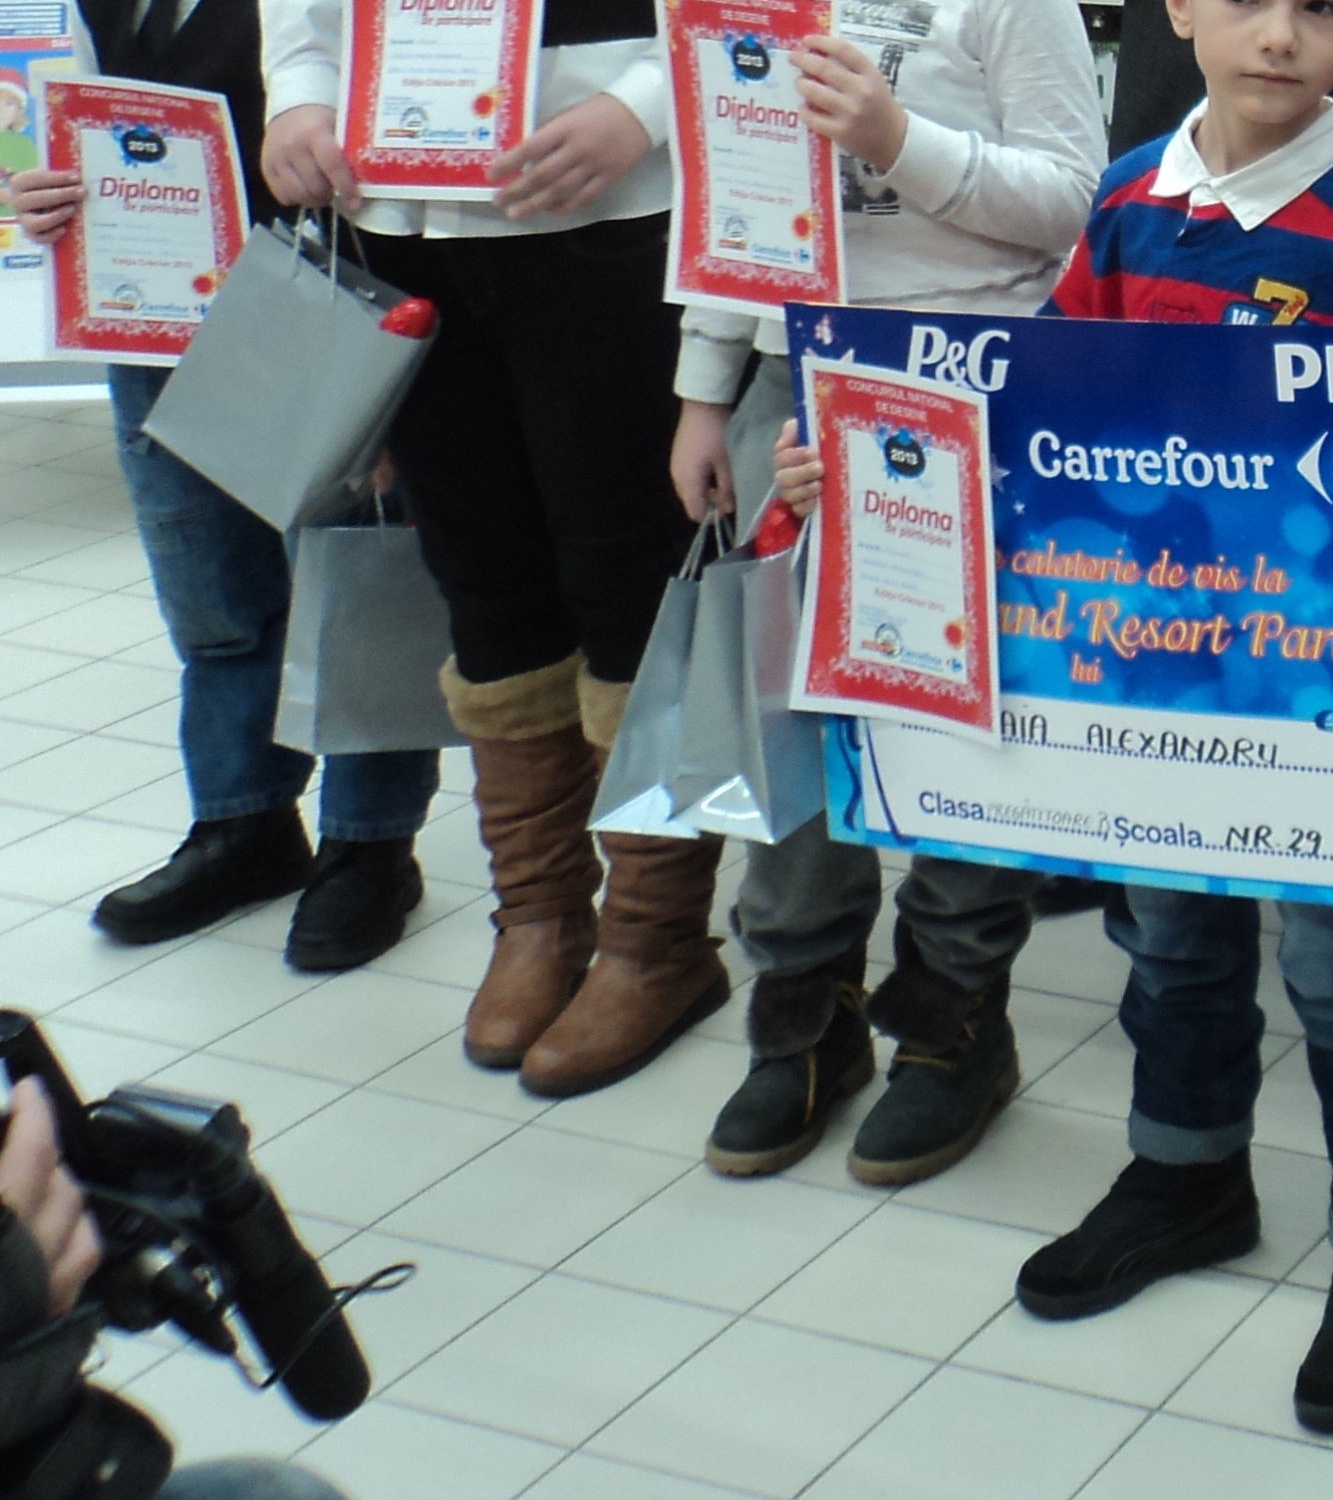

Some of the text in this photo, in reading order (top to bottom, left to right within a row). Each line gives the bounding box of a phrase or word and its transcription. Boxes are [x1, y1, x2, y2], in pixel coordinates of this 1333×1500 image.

[716, 95, 798, 128] Diploma
[100, 177, 199, 203] Diploma
[906, 325, 1011, 394] P&G
[890, 449, 919, 466] 2013
[1028, 431, 1274, 490] Carrefour
[864, 490, 953, 532] Diploma
[1012, 540, 1292, 594] calatorie de vis la
[1081, 598, 1233, 660] Resort
[1070, 652, 1103, 683] lui
[1086, 722, 1279, 768] ALEXANDRU
[918, 790, 985, 822] Clasa
[1114, 817, 1203, 849] Școala
[1288, 827, 1323, 857] 29
